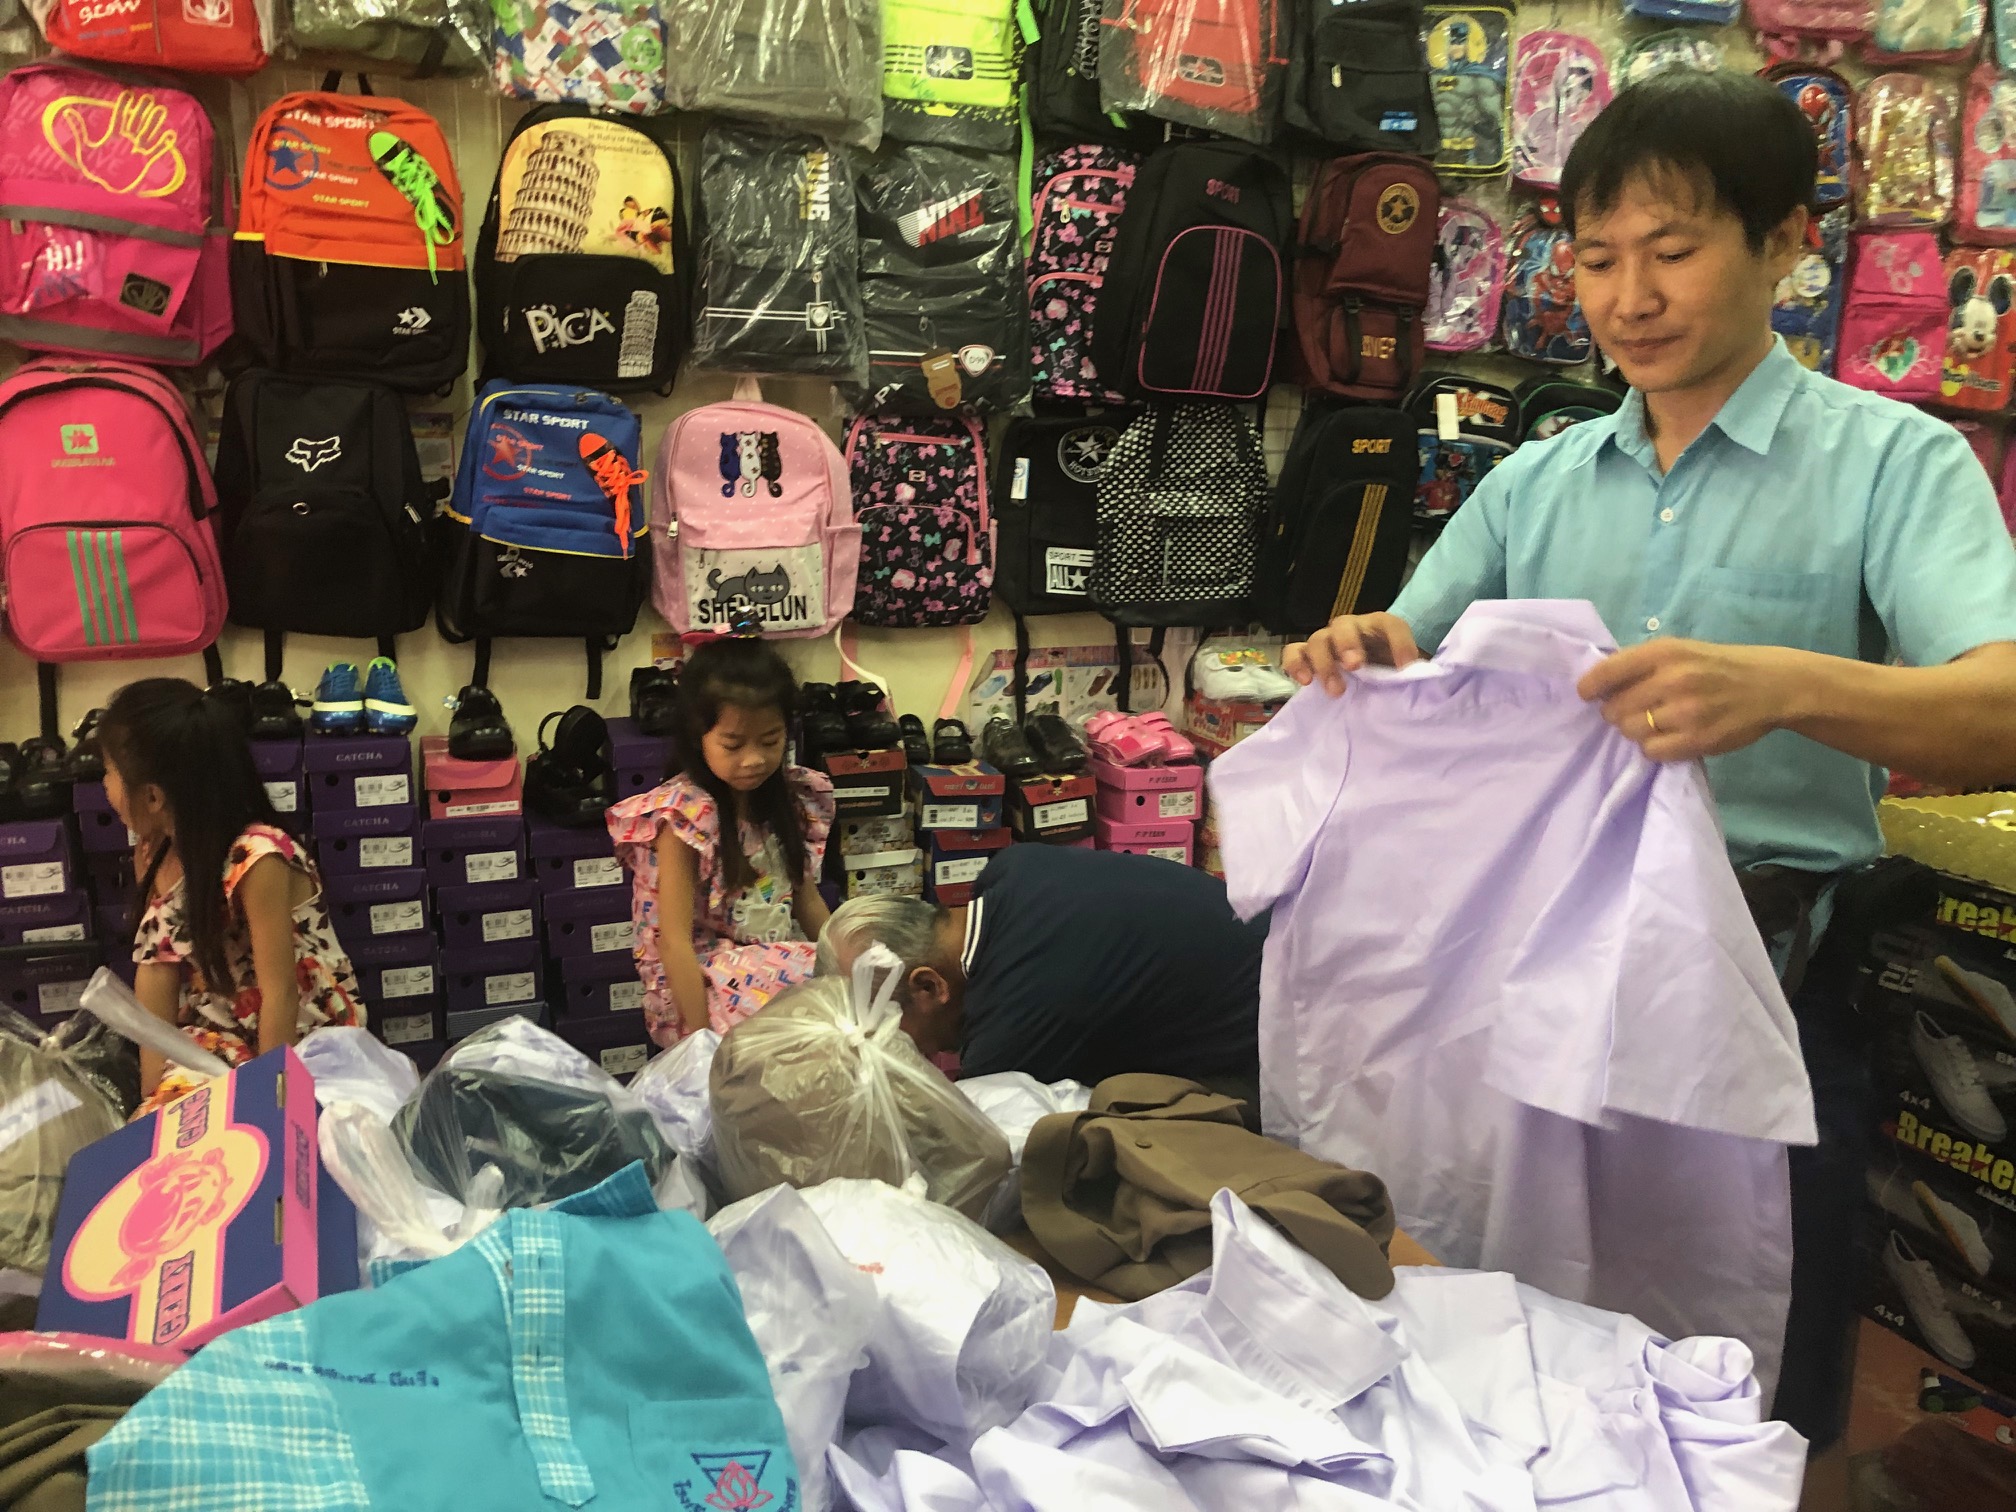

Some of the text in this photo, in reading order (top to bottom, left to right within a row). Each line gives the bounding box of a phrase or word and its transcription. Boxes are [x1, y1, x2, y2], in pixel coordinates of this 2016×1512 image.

[301, 169, 359, 186] STAR SPORT
[312, 193, 370, 209] STAR SPORT
[525, 307, 616, 354] PICA
[502, 408, 591, 430] STAR SPORT
[1351, 438, 1393, 454] SPORT
[515, 463, 566, 480] STAR SPORT
[1048, 551, 1077, 561] SPORT
[1050, 565, 1071, 589] ALL
[335, 752, 384, 762] CATCHA
[344, 816, 390, 828] CATCHA
[352, 880, 400, 893] CATCHA
[1937, 893, 2016, 943] reak
